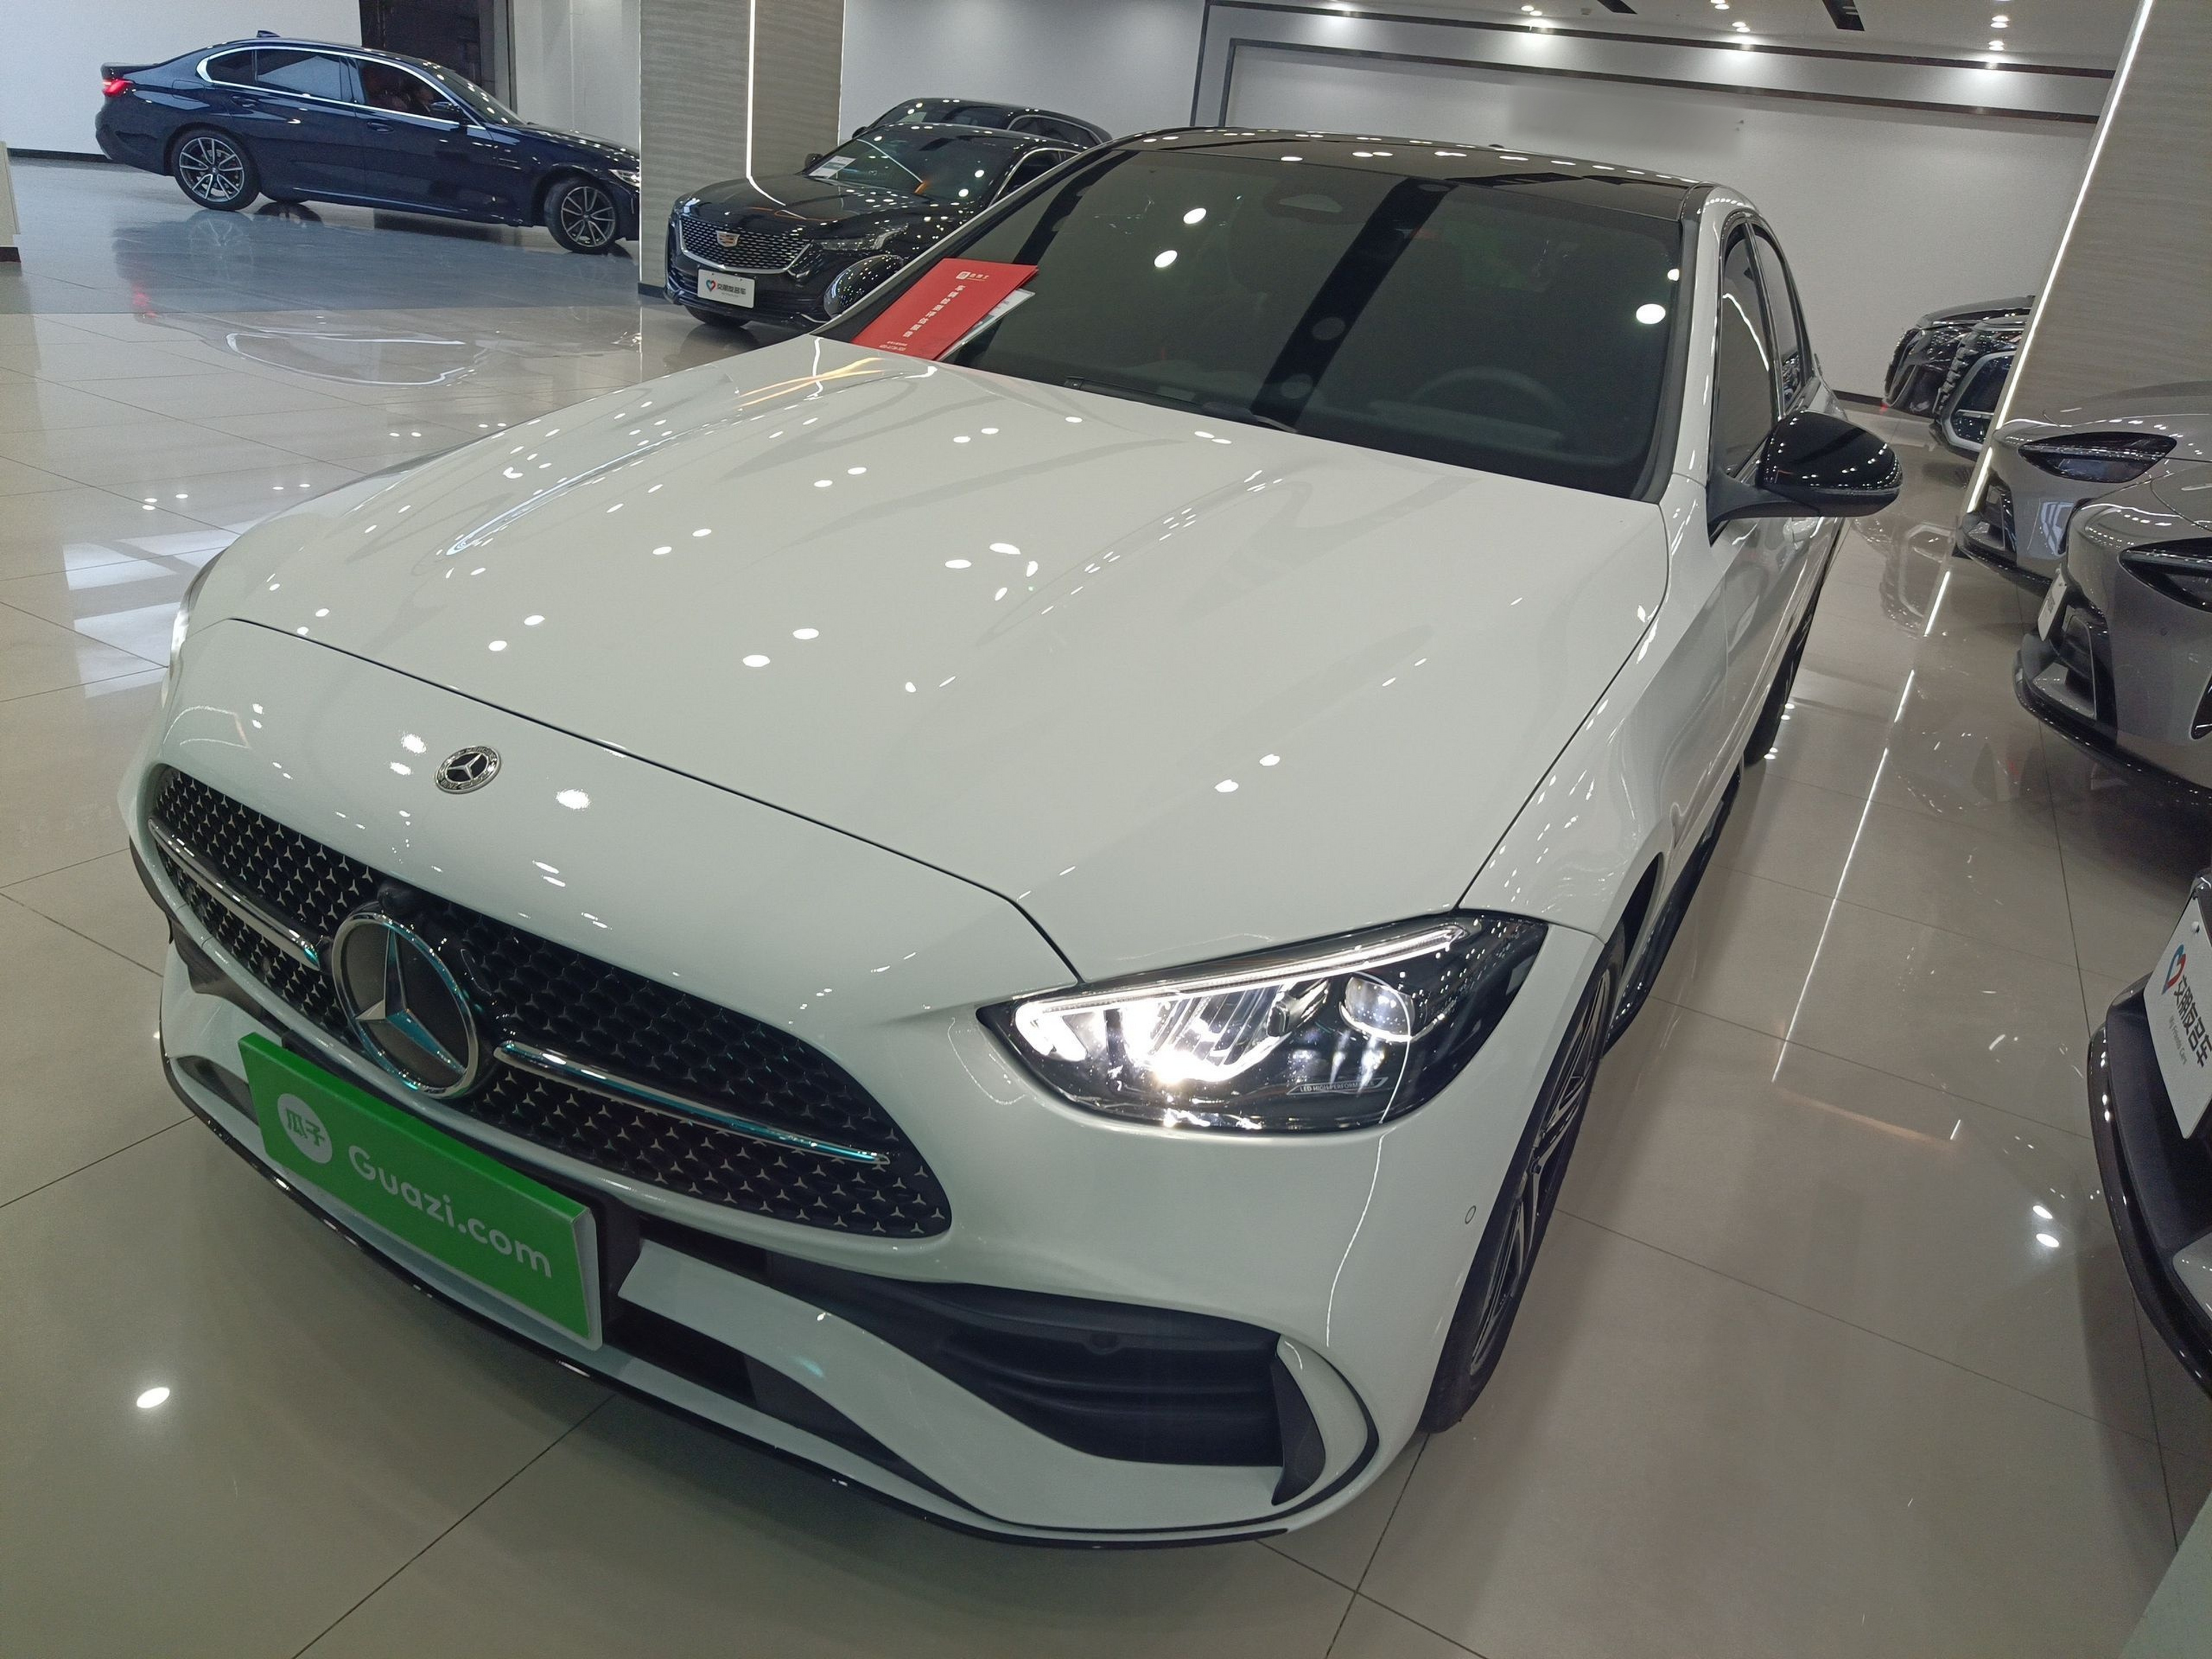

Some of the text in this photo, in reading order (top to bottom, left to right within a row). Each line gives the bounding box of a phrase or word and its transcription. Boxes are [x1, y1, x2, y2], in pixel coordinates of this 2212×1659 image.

[2173, 974, 2212, 1067] 交朋友名车
[286, 1108, 325, 1147] 瓜子
[349, 1145, 552, 1279] Guazi.com
